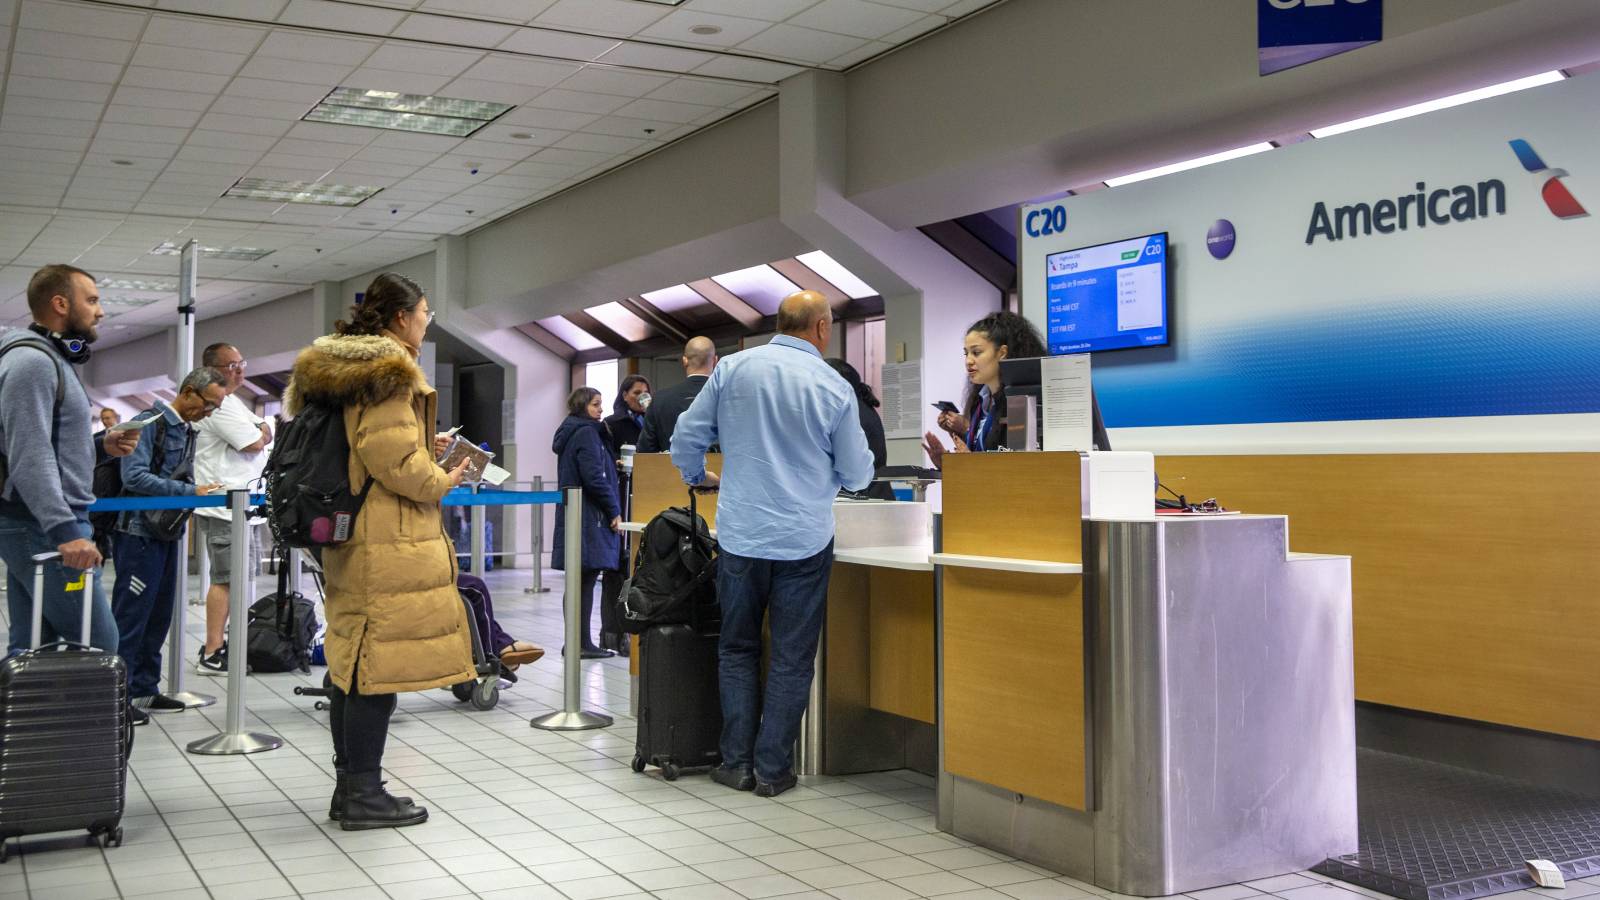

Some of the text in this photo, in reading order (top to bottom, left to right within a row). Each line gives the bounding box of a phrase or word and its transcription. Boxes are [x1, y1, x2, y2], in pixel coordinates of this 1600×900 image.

[1305, 178, 1506, 246] American
[1026, 205, 1066, 238] C20
[1145, 244, 1161, 256] C20
[1059, 262, 1079, 271] Tampa
[1077, 278, 1096, 286] minutes
